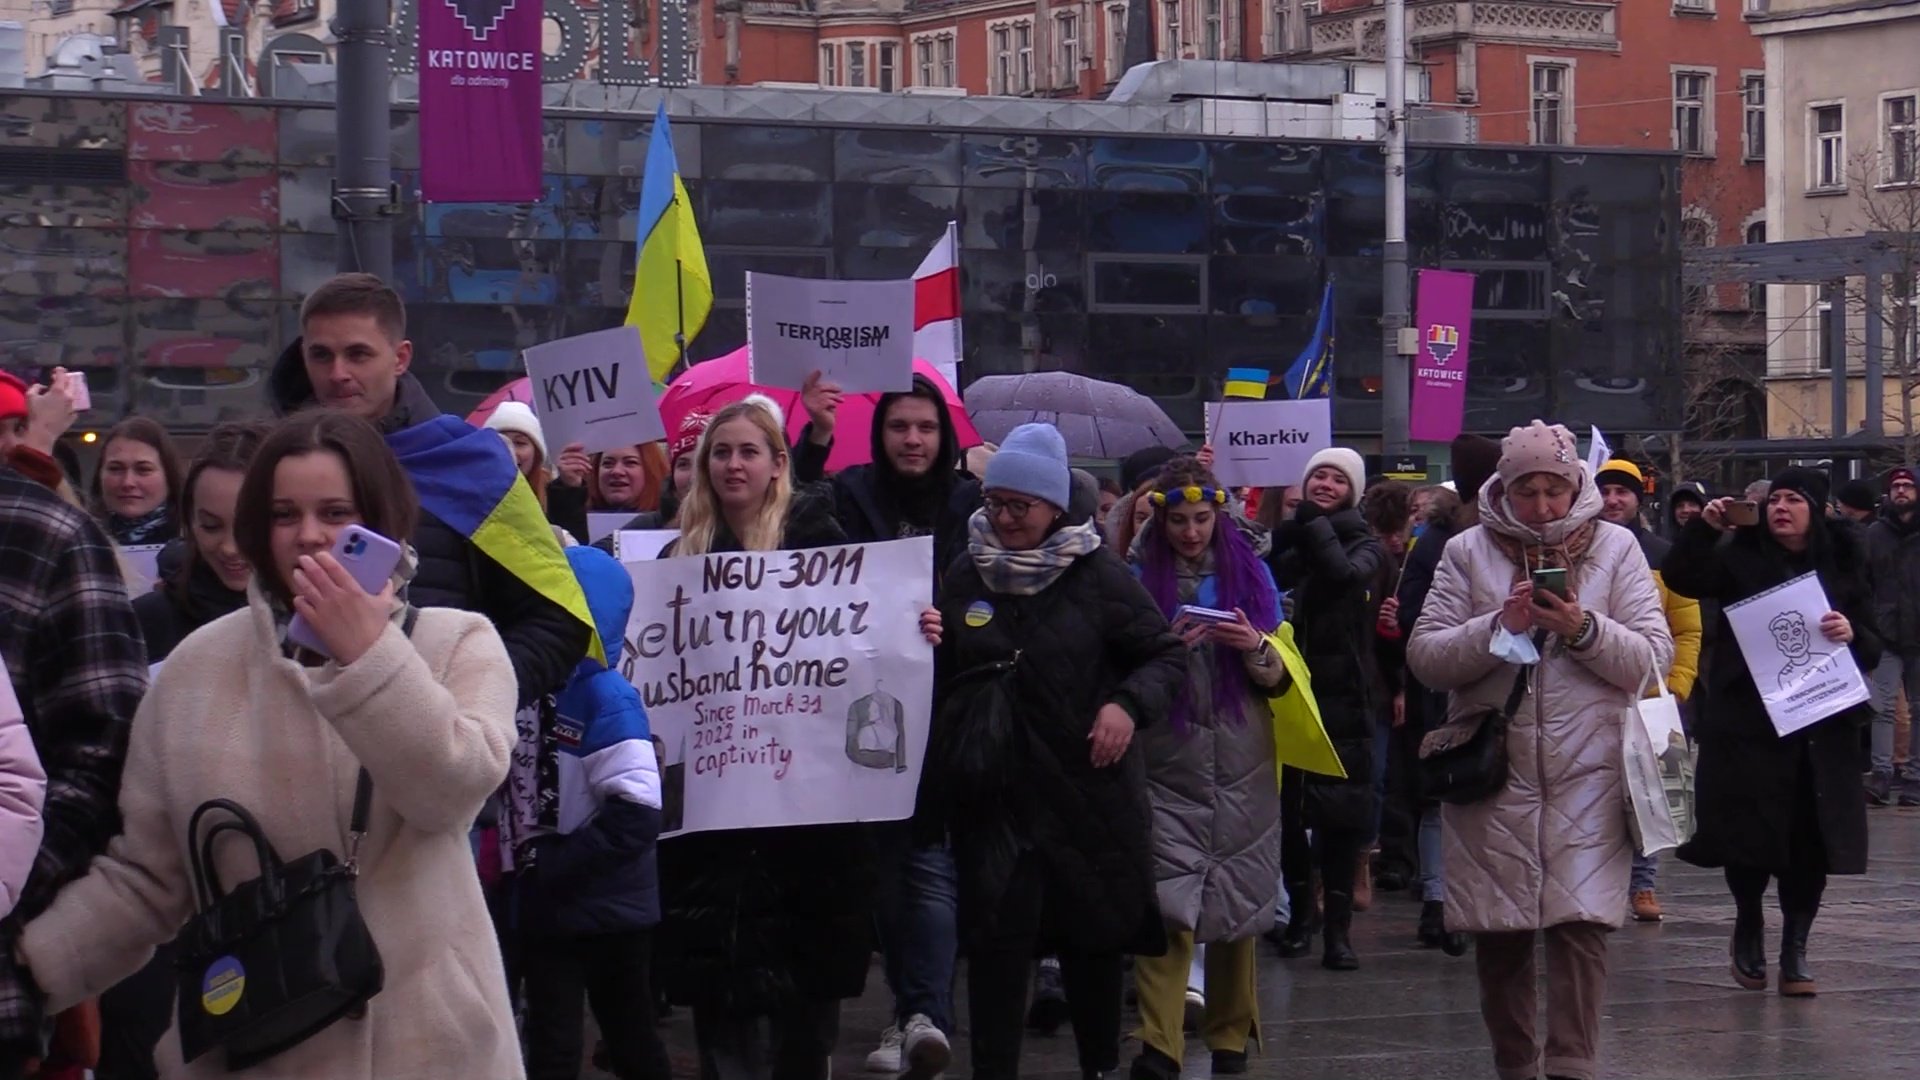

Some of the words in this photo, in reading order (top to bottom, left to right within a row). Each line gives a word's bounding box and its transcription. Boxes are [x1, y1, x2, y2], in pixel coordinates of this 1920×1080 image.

[428, 50, 535, 70] KATOWICE
[776, 322, 890, 342] TERRORISM
[543, 362, 620, 412] KYIV
[1417, 368, 1464, 381] KATOWICE
[1229, 428, 1310, 446] Kharkiv
[703, 546, 865, 593] NGU-3011
[768, 601, 870, 658] your
[746, 640, 849, 692] home
[694, 701, 736, 726] Since
[744, 693, 794, 716] March
[798, 694, 823, 715] 31
[693, 722, 734, 749] 2022
[743, 725, 758, 739] in
[695, 737, 792, 780] captivity
